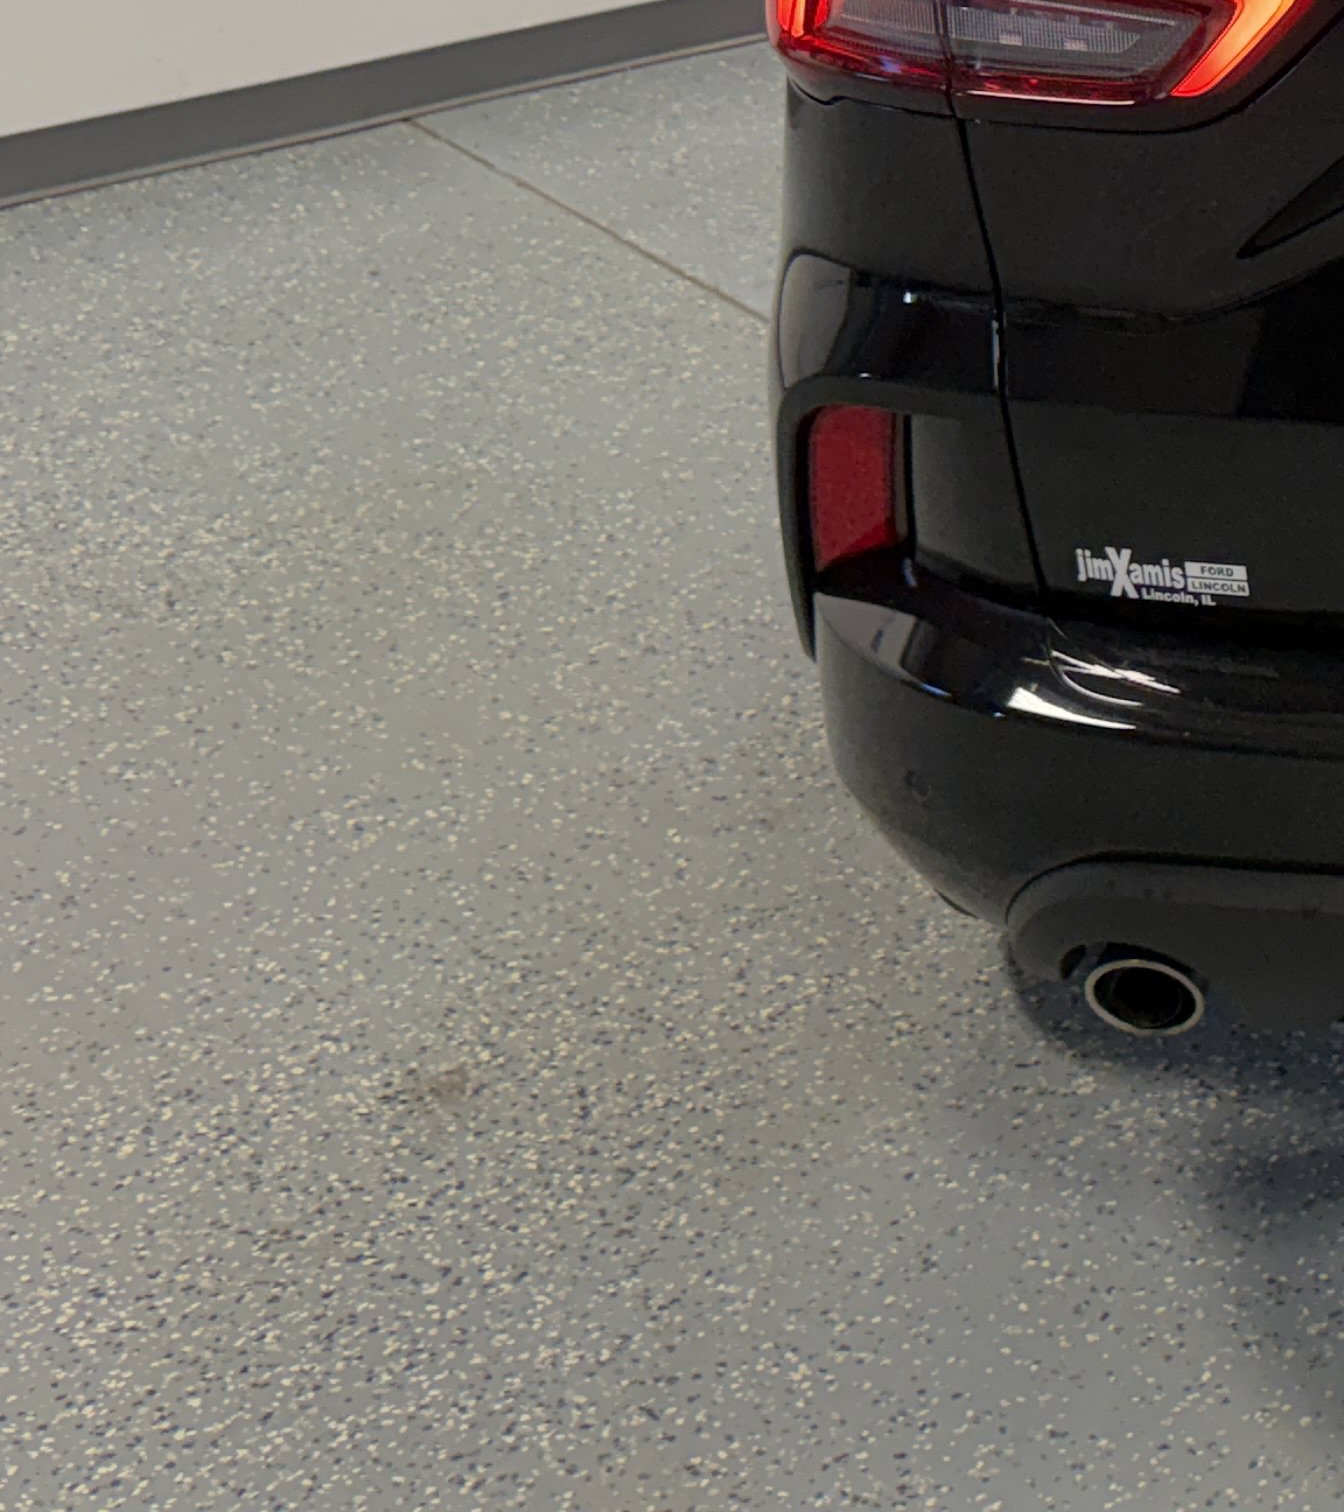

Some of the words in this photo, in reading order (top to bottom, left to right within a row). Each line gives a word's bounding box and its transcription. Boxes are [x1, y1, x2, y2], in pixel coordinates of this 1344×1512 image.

[1200, 565, 1234, 577] FORD
[1191, 580, 1247, 594] LINCOLN
[1141, 587, 1200, 607] Lincoln,
